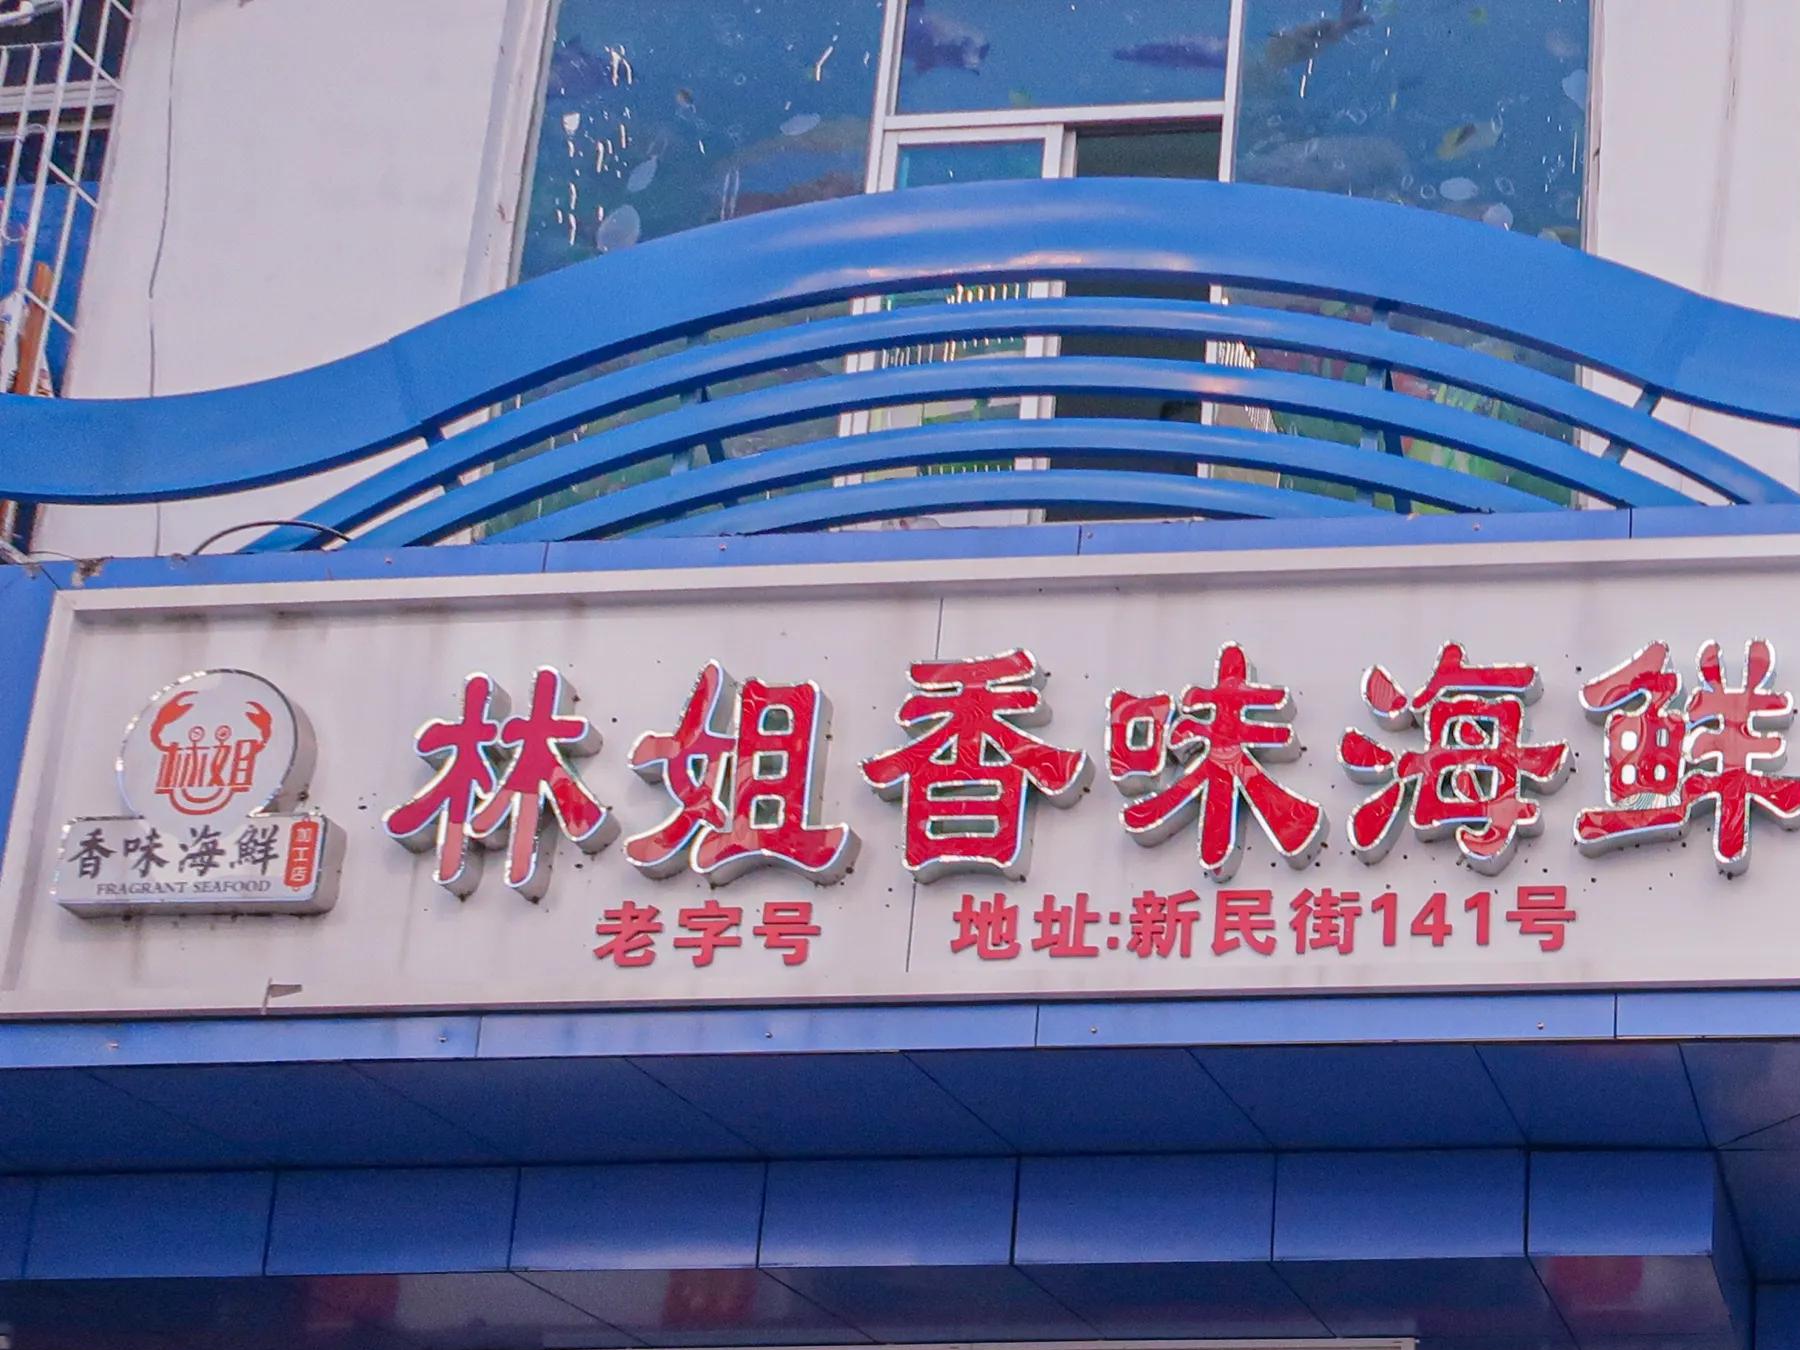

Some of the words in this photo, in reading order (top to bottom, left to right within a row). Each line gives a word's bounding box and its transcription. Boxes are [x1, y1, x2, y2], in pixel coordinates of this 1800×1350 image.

[155, 740, 256, 795] 林姐
[291, 826, 311, 883] 加工店
[96, 881, 186, 897] FRAGRANT
[192, 880, 271, 894] SEAFOOD
[594, 900, 821, 968] 老字号
[951, 886, 1577, 960] 地址:新民街141号
